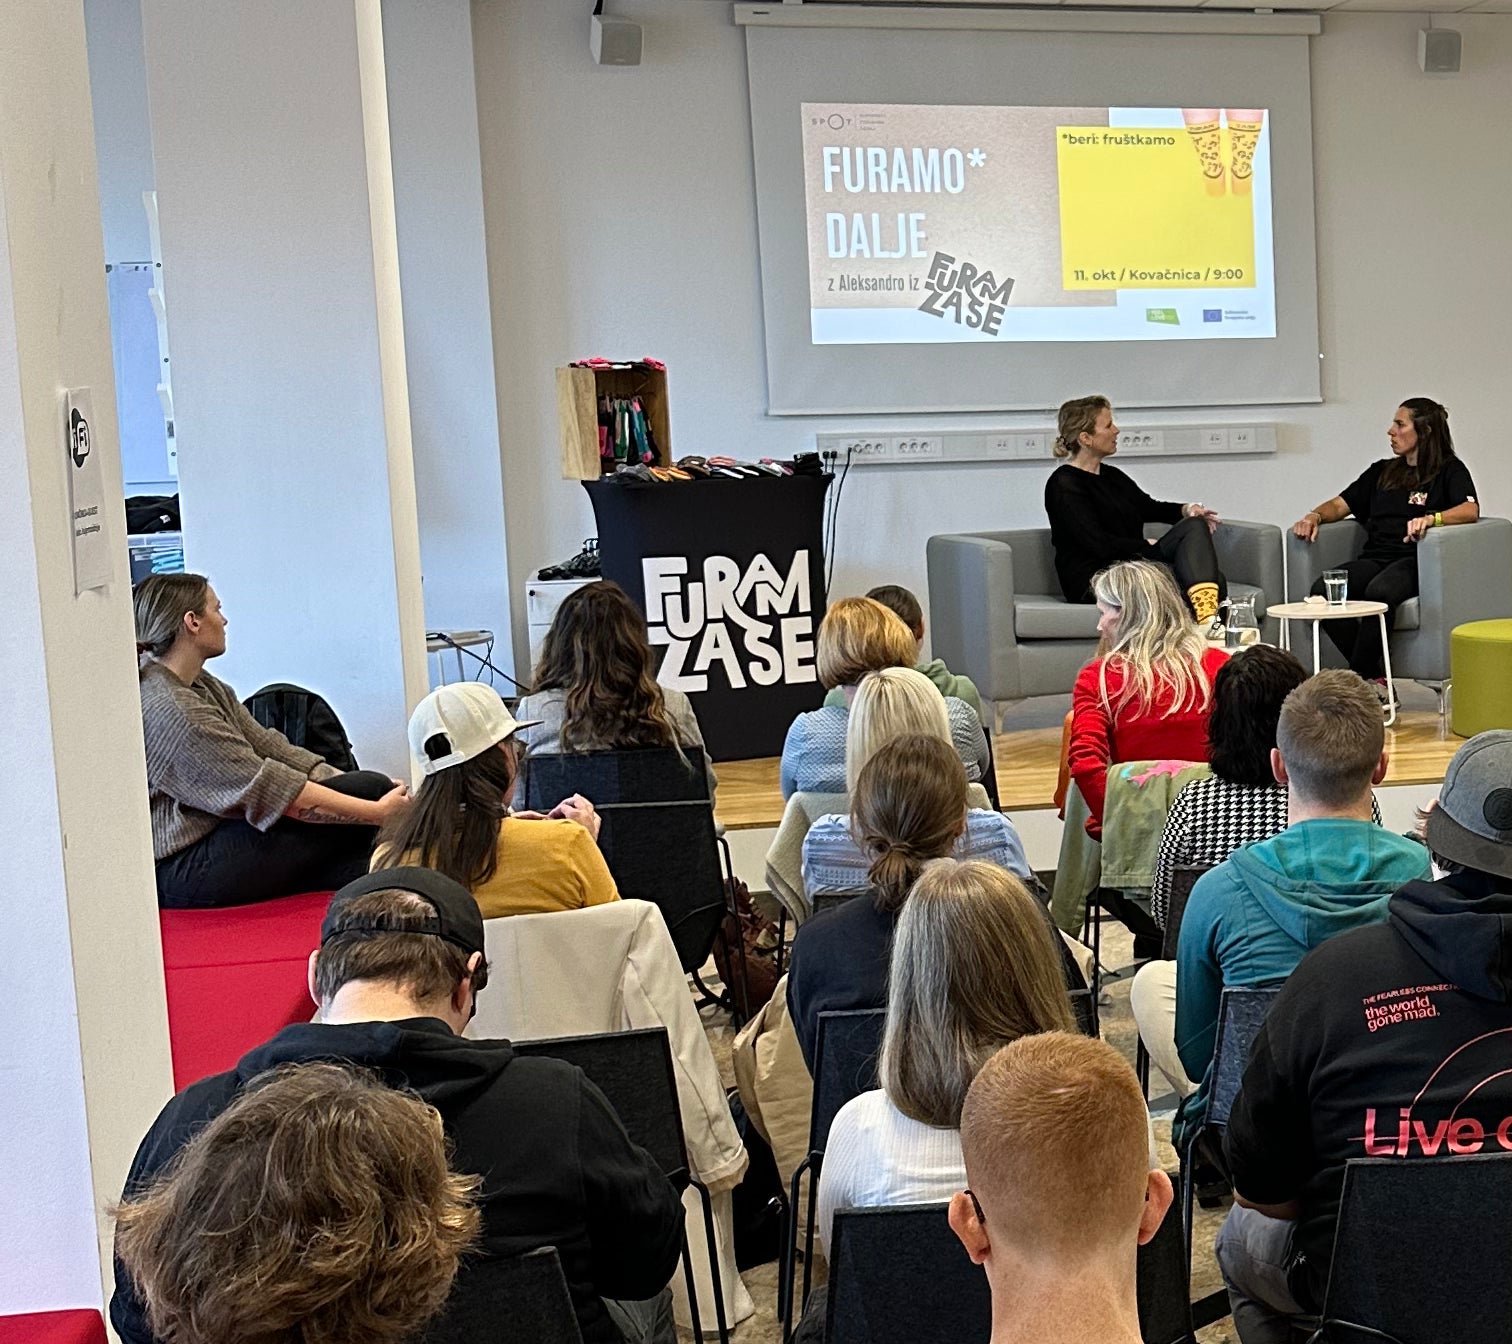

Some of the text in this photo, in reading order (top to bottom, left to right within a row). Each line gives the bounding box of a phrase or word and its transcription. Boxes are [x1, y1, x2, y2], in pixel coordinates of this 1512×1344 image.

[1103, 132, 1176, 146] fruštkamo
[825, 212, 929, 259] DALJE
[828, 273, 920, 292] z Aleksandro iz
[1073, 267, 1244, 282] 11. okt / Kovačnica / 9:00
[1364, 994, 1431, 1020] the world
[1367, 1012, 1403, 1033] gone
[1364, 1107, 1486, 1157] Live
